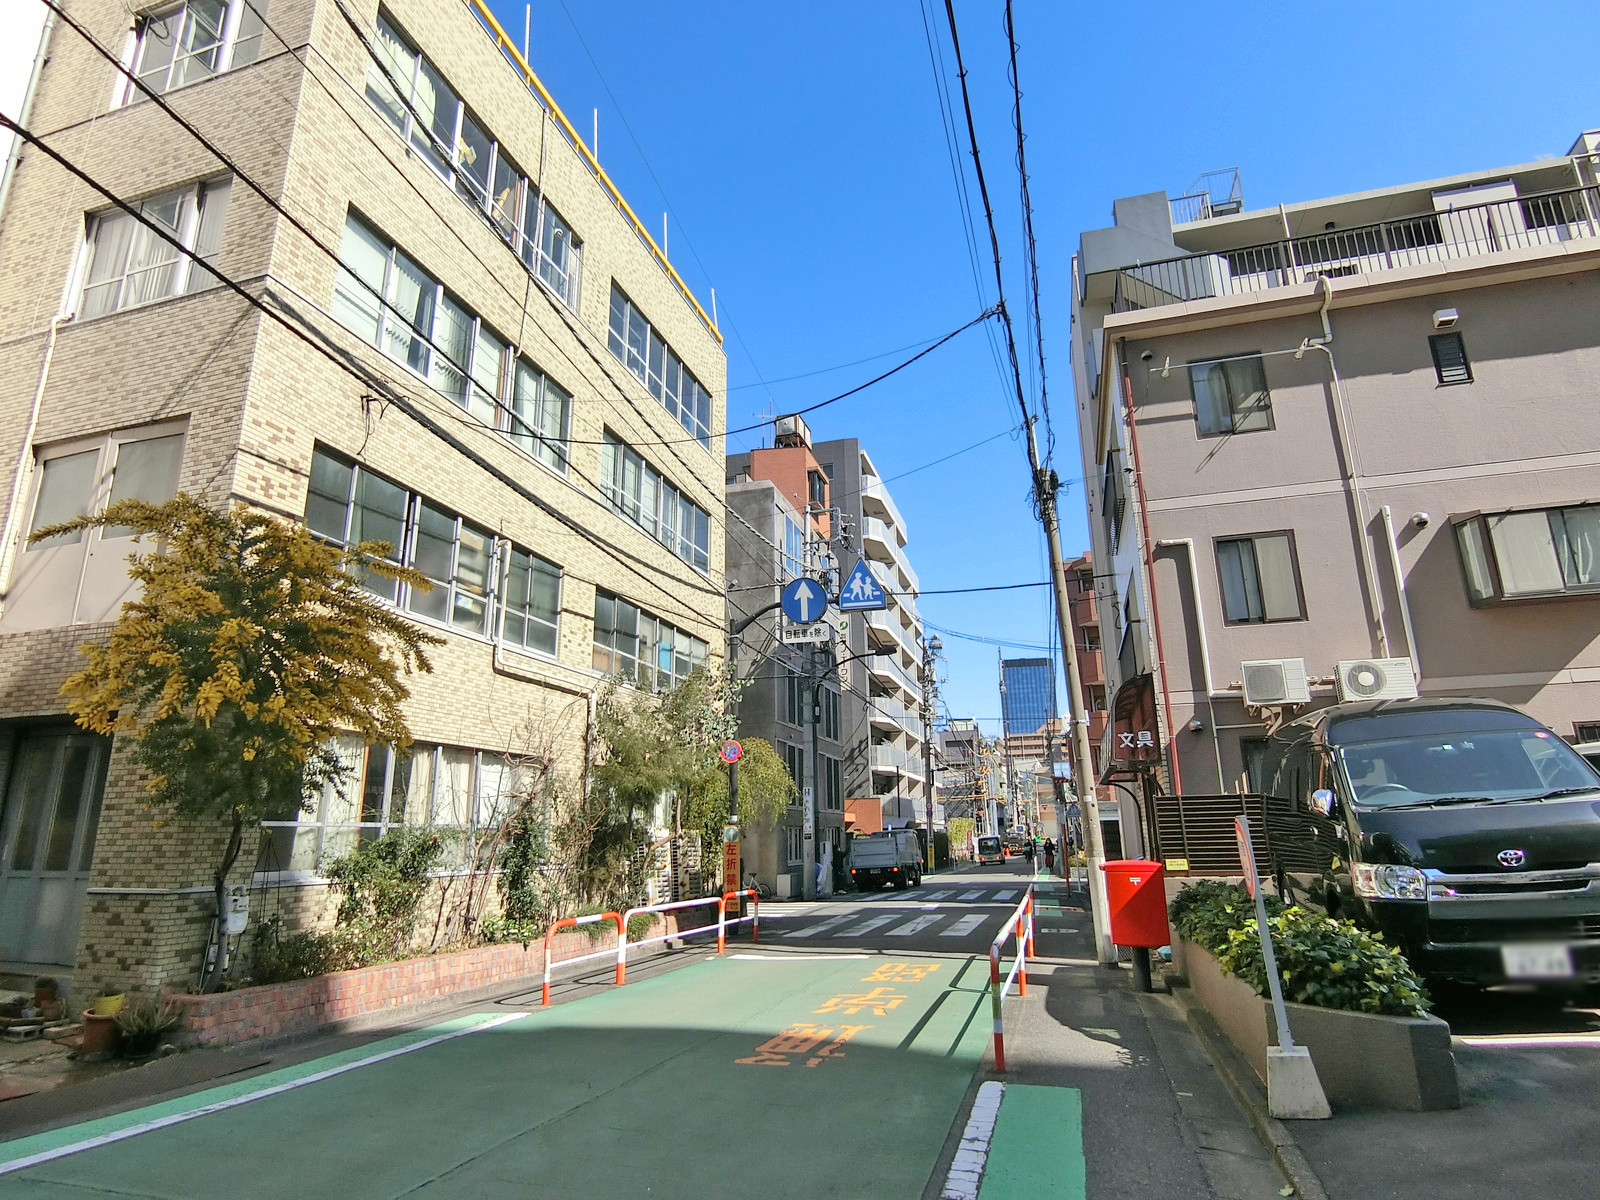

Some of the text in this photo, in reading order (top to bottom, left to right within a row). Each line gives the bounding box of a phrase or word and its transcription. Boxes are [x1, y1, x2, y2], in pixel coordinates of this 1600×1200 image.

[785, 627, 827, 640] 自転車を除く
[1117, 731, 1154, 748] 文具
